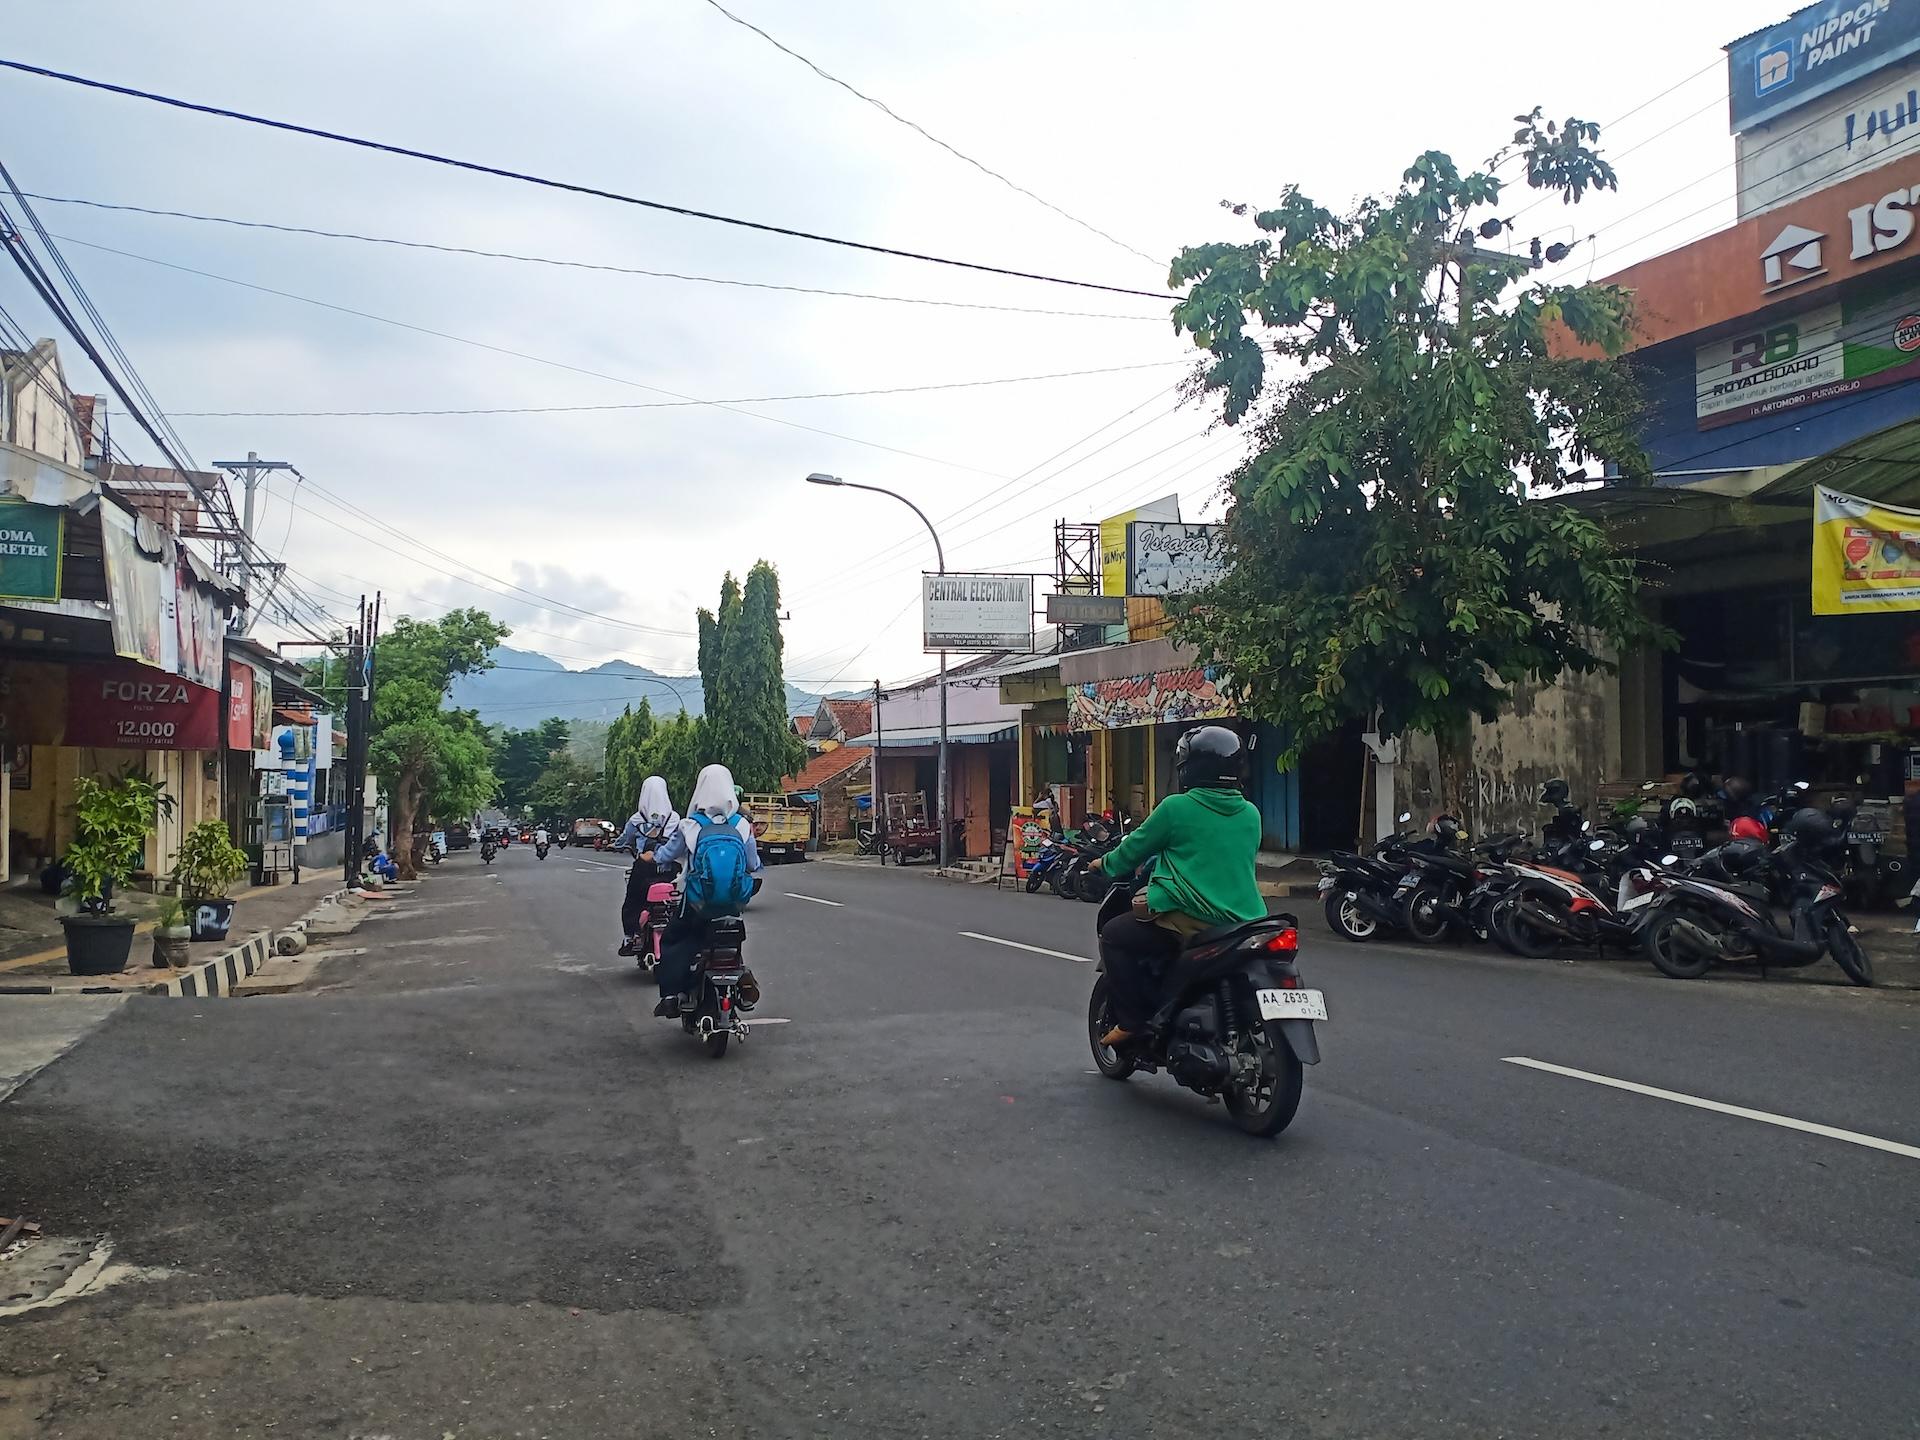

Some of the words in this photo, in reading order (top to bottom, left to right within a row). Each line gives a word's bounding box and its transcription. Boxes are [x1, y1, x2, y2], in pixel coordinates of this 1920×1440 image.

[1807, 20, 1876, 71] PAINT
[1732, 323, 1799, 375] RB
[1811, 380, 1861, 401] PURWOREJO
[1139, 528, 1207, 553] Istana
[929, 581, 968, 602] CENTRAL
[969, 581, 1025, 602] ELECTRONIK
[102, 680, 190, 704] FORZA
[116, 720, 175, 737] 12.000
[1262, 992, 1278, 1005] AA
[1282, 992, 1309, 1004] 2639
